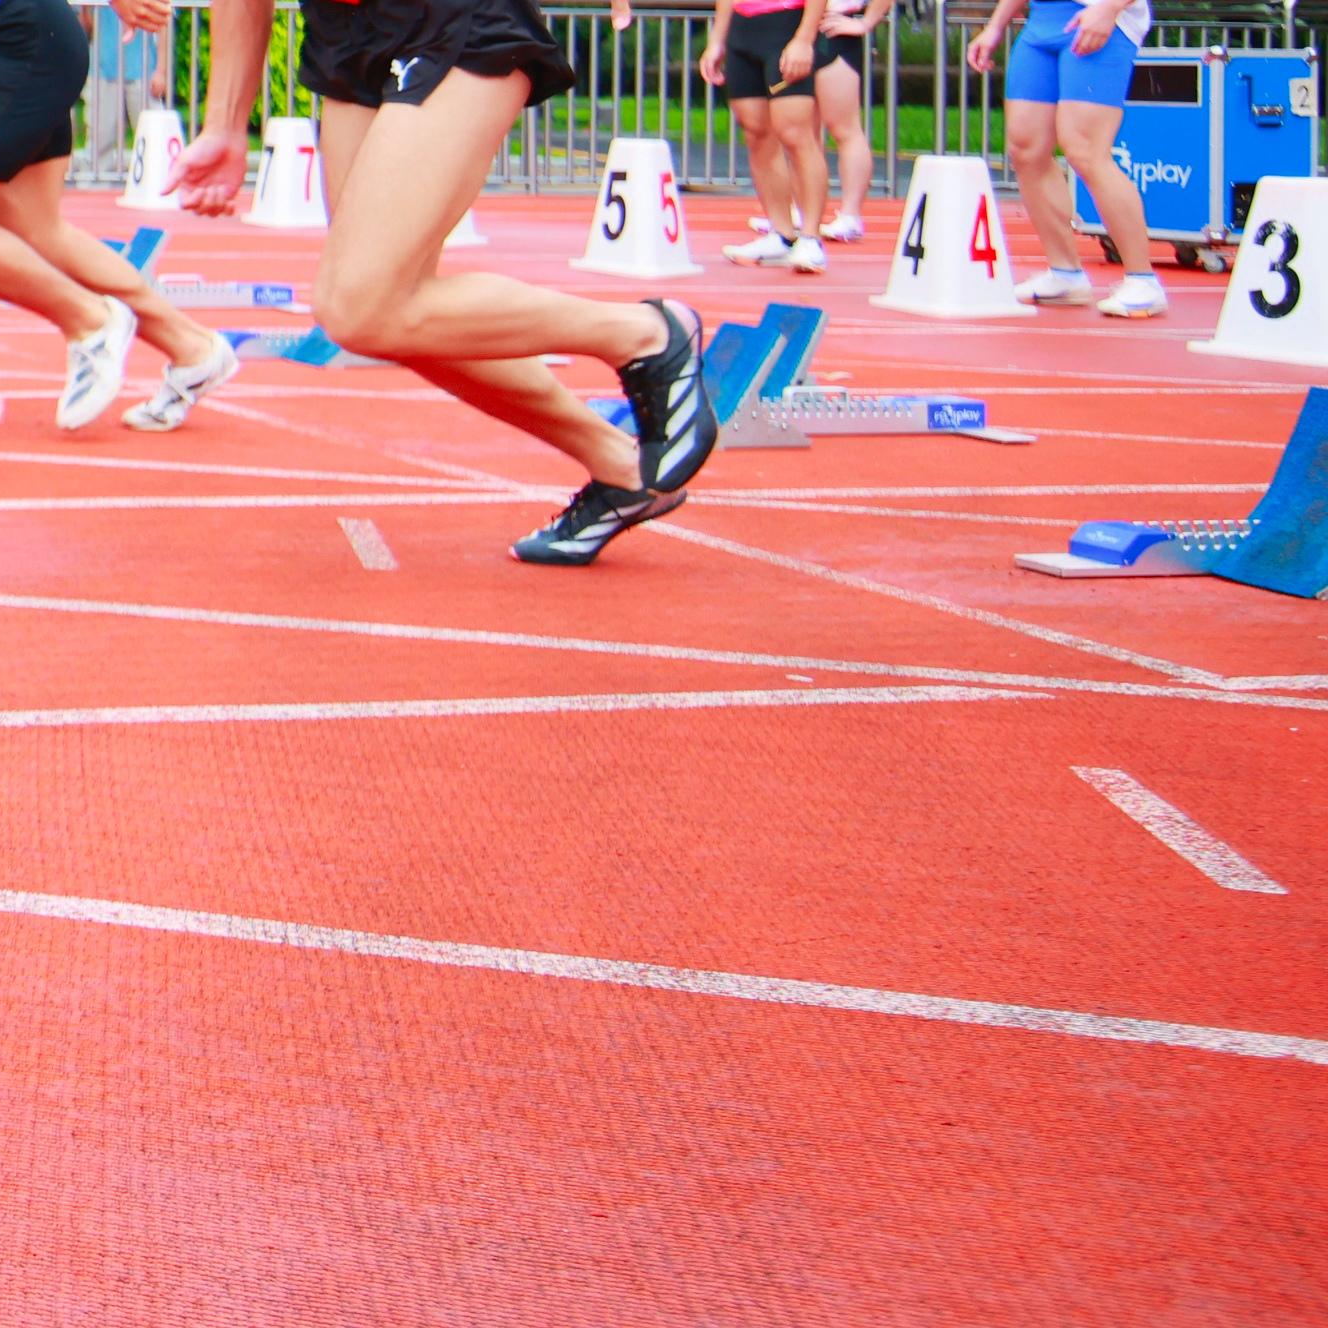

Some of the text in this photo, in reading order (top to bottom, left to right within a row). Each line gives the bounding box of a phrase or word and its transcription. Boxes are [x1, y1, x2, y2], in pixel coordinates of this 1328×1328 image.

[1298, 84, 1311, 109] 2
[132, 137, 146, 185] 8
[260, 145, 274, 202] 7
[297, 146, 315, 201] 7
[601, 171, 628, 242] 5
[658, 172, 681, 244] 5
[900, 193, 927, 276] 4
[969, 194, 998, 279] 4
[1248, 219, 1301, 319] 3
